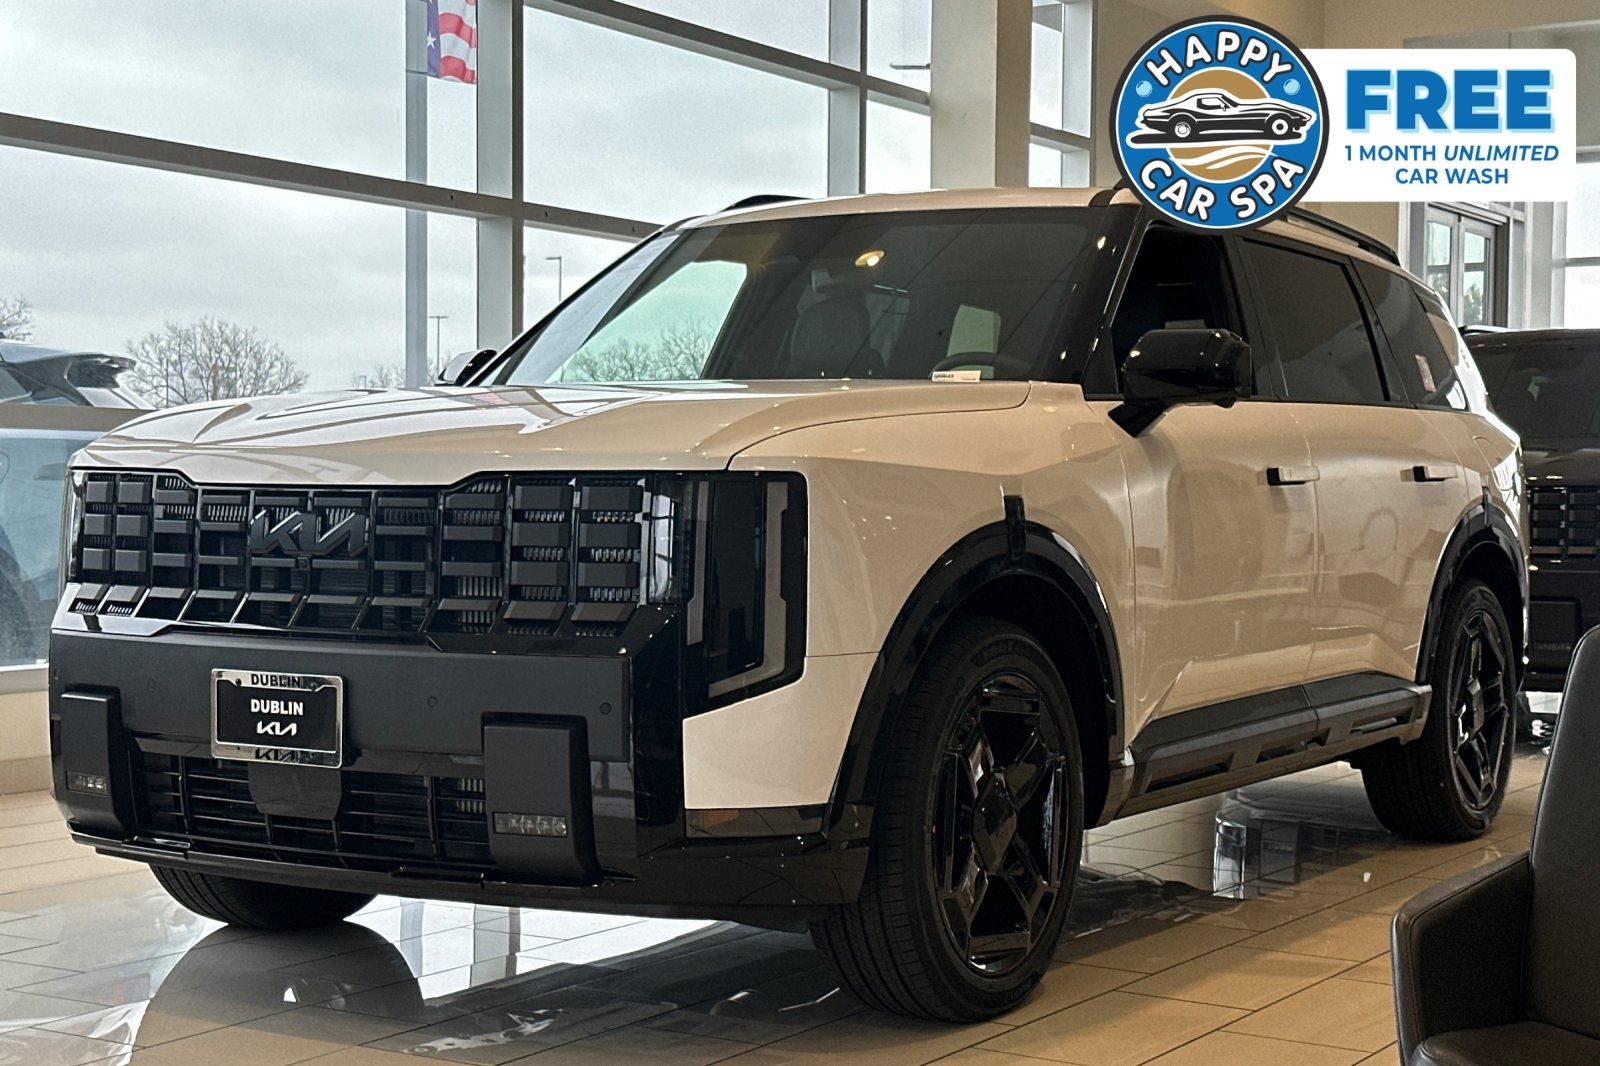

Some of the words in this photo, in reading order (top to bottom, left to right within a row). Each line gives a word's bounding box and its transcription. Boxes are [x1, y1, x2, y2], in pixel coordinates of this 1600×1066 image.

[249, 510, 368, 557] KIA
[251, 673, 302, 688] DUBLIN
[251, 699, 304, 715] DUBLIN
[256, 721, 297, 736] KIA
[255, 748, 296, 762] KIA
